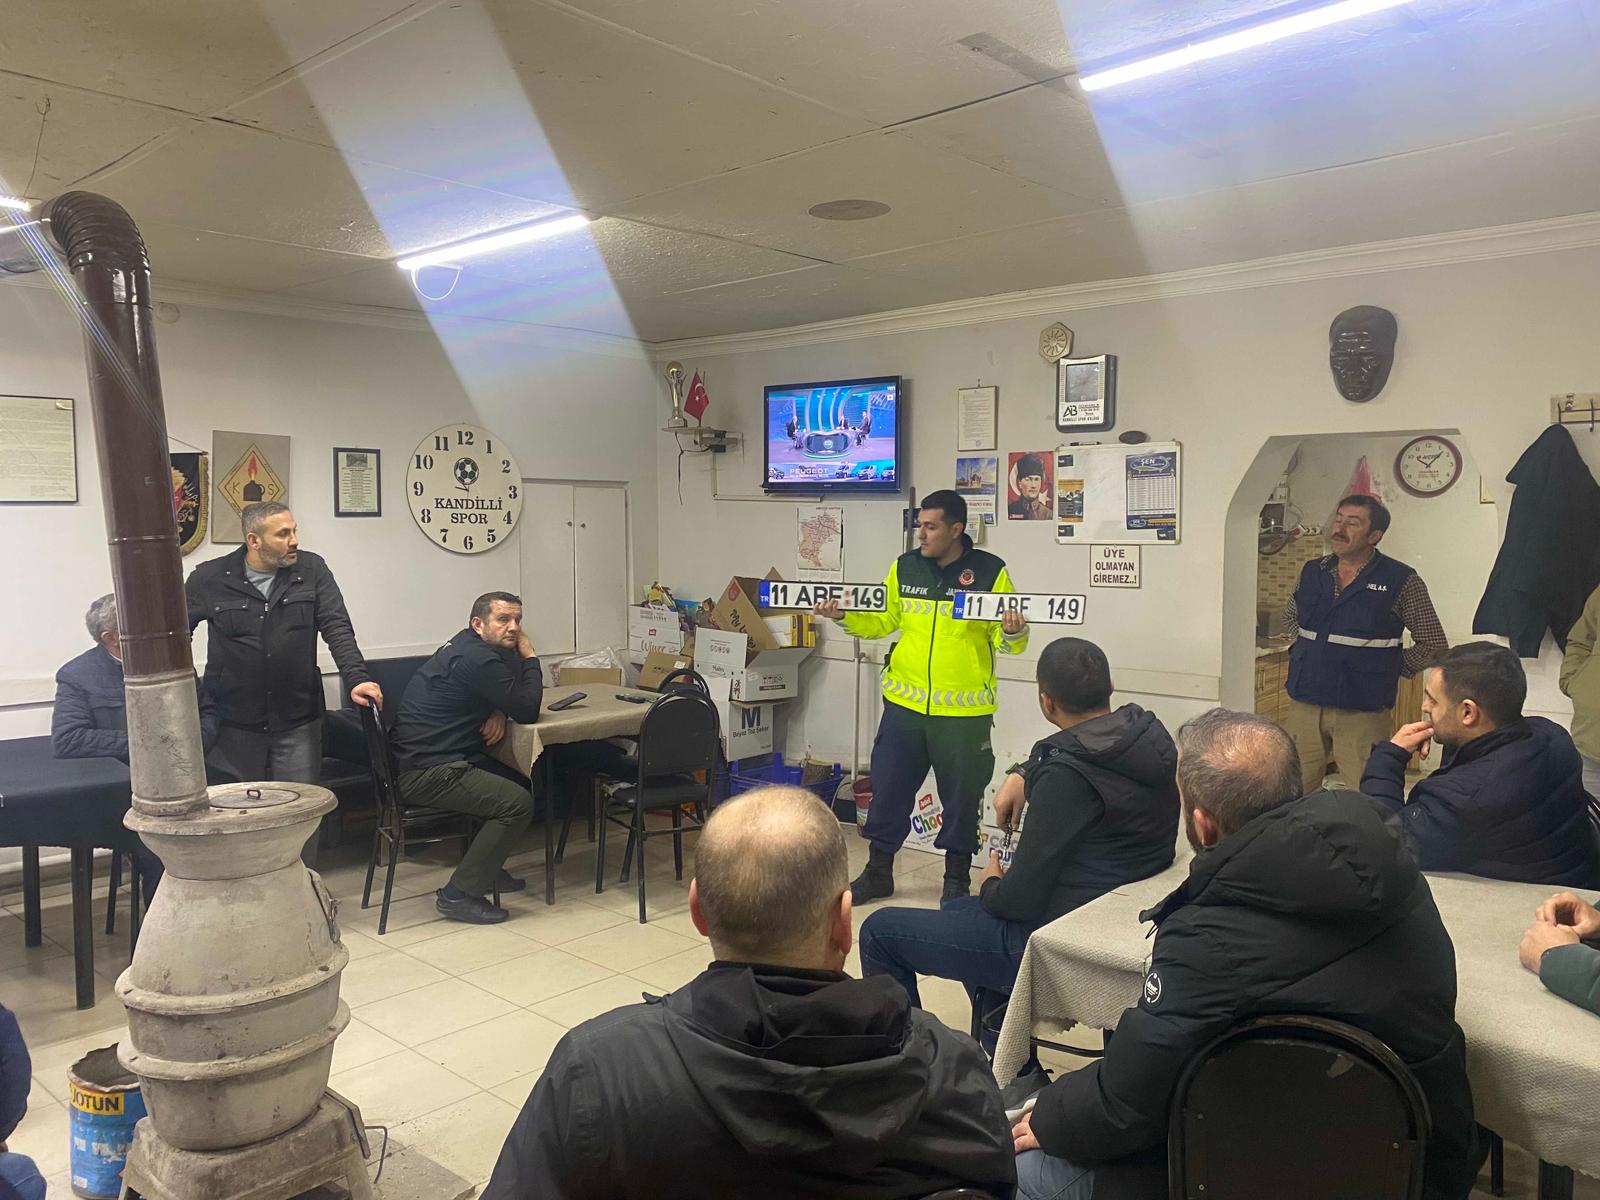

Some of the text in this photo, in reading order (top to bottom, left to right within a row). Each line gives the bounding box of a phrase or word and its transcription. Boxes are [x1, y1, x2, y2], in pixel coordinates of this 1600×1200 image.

[435, 436, 449, 451] 11
[457, 431, 474, 445] 12
[486, 440, 492, 453] 1
[415, 454, 433, 470] 10
[502, 459, 511, 473] 2
[232, 481, 240, 494] K
[267, 484, 274, 495] S
[413, 482, 423, 496] 9
[508, 485, 517, 499] 3
[434, 496, 503, 510] KANDİLLİ
[421, 509, 431, 523] 8
[450, 513, 488, 524] SPOR
[503, 511, 512, 524] 4
[440, 528, 448, 543] 7
[487, 529, 496, 543] 5
[463, 536, 473, 550] 6
[1104, 548, 1125, 558] ÜYE
[1095, 562, 1134, 571] OLMAYAN
[772, 584, 788, 605] 11
[852, 587, 884, 608] 149
[967, 596, 983, 617] 11
[1048, 598, 1079, 619] 149
[742, 706, 760, 729] M
